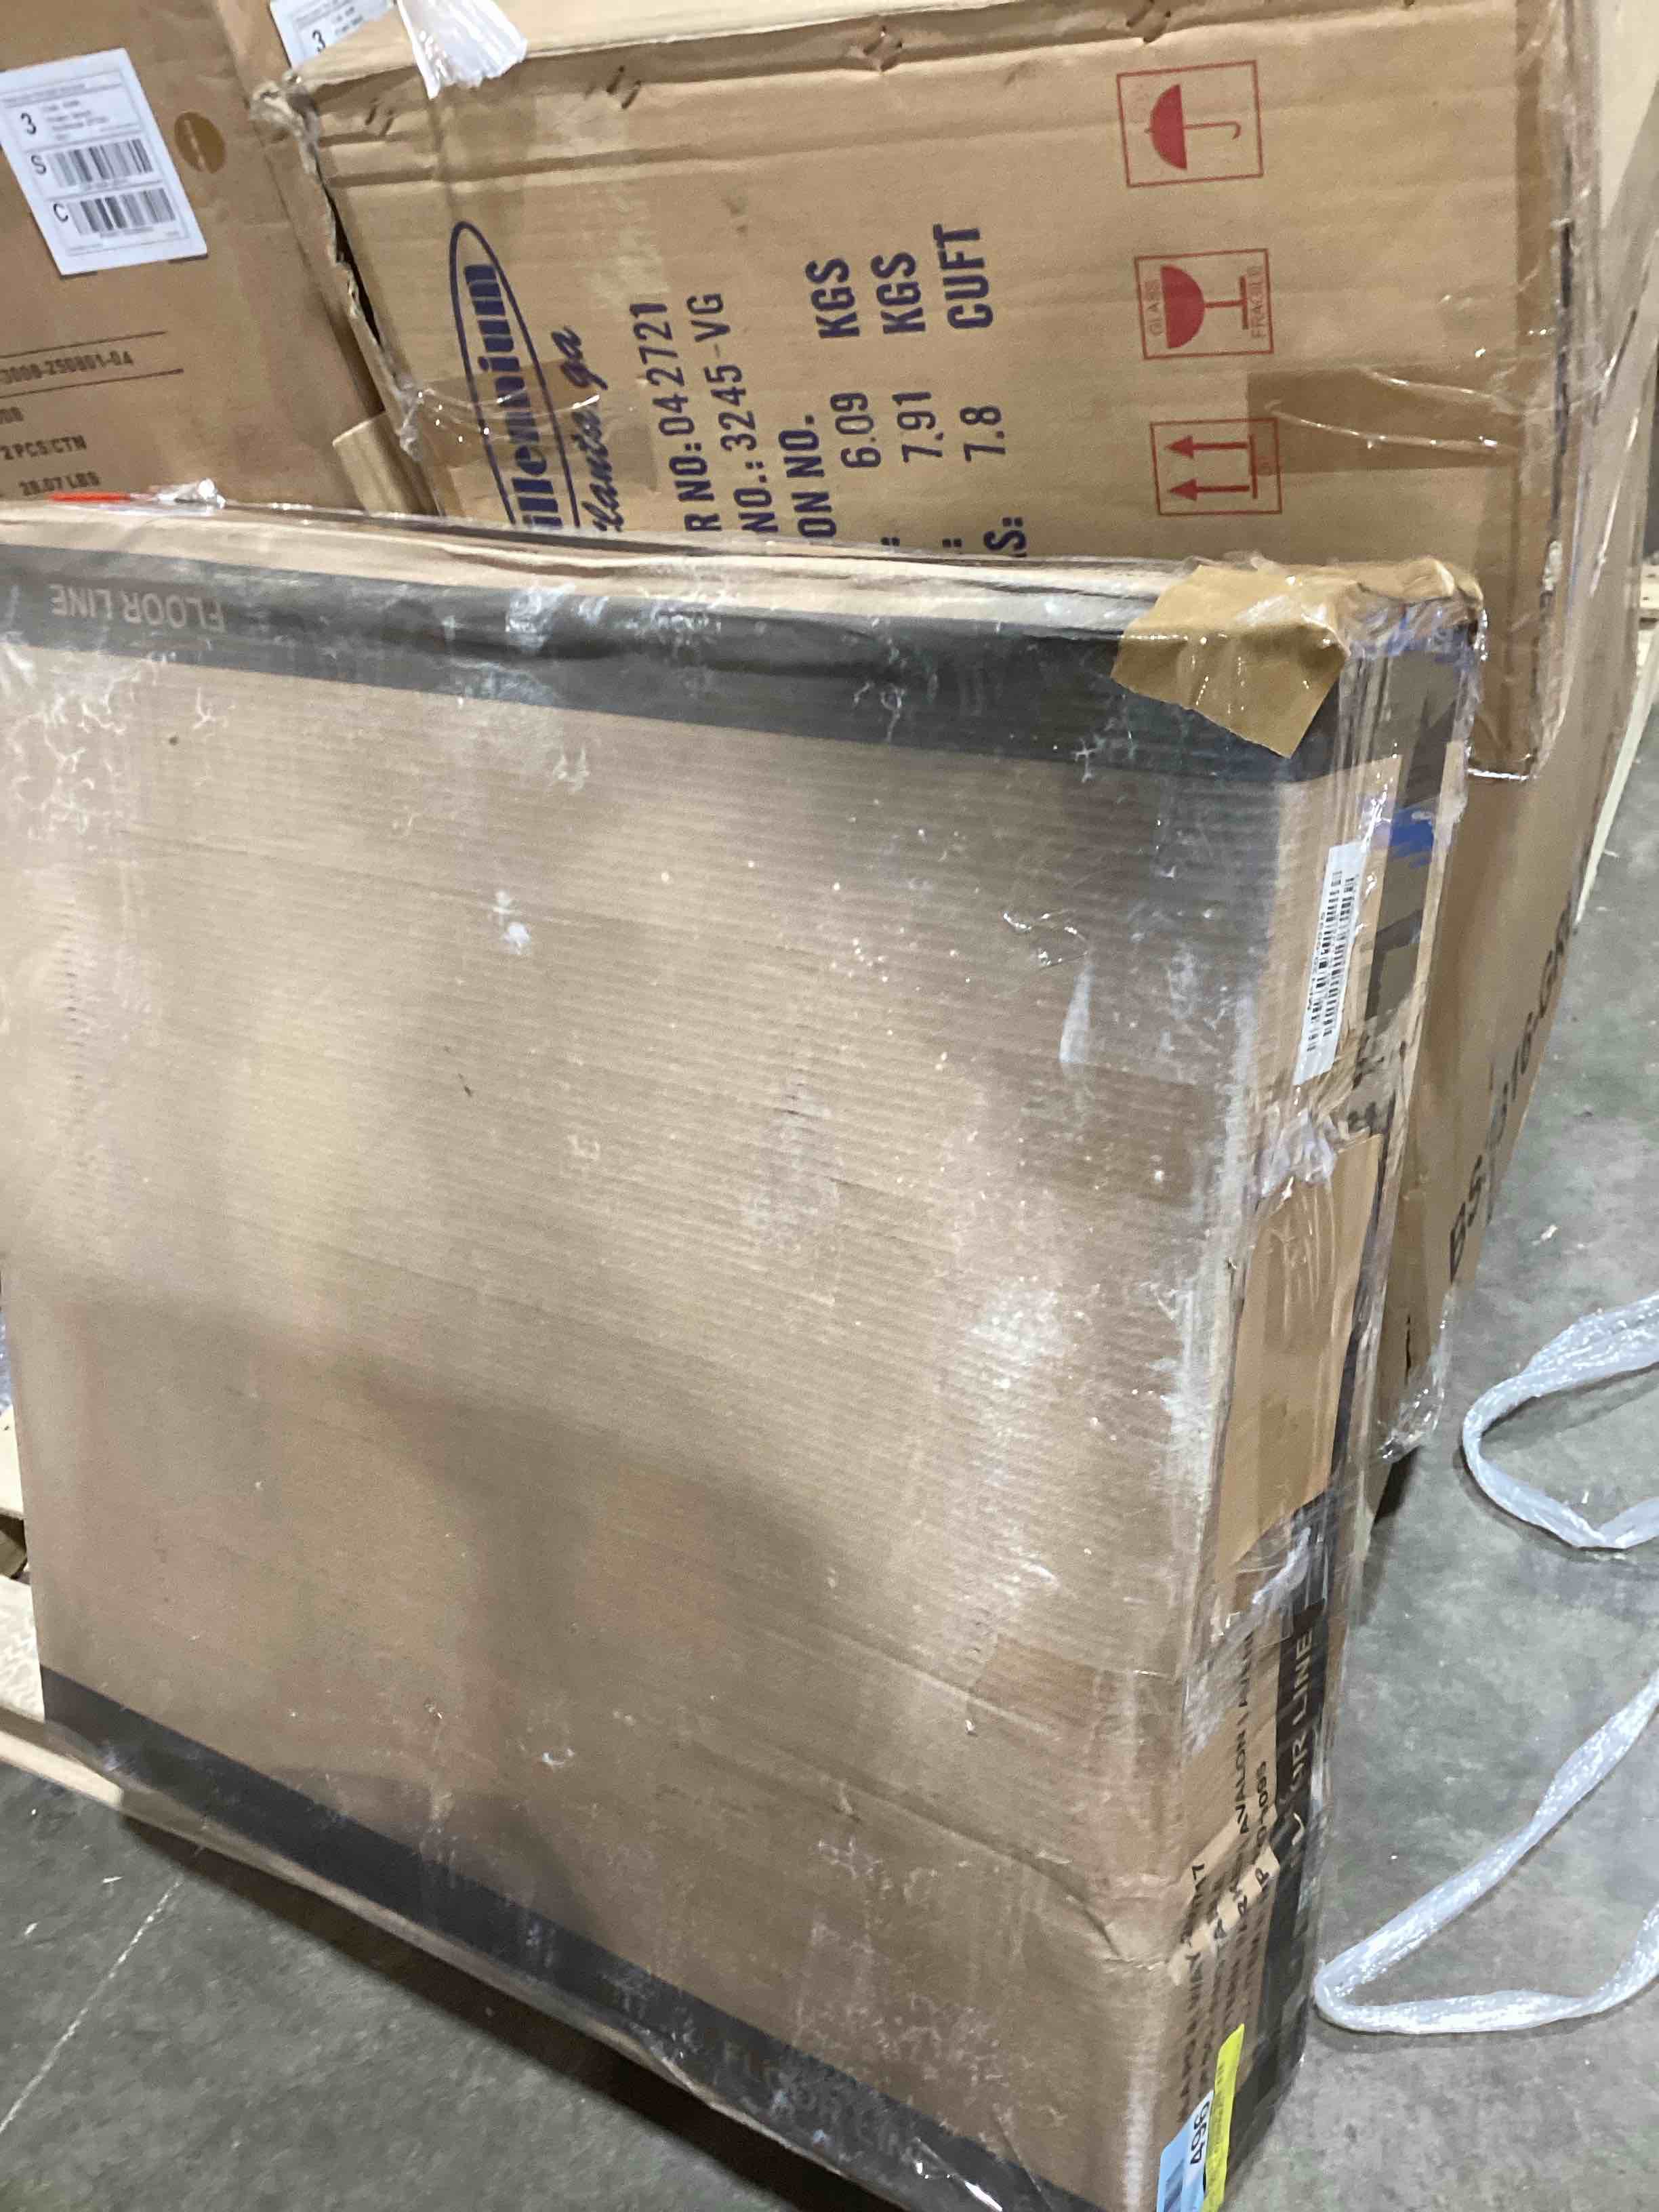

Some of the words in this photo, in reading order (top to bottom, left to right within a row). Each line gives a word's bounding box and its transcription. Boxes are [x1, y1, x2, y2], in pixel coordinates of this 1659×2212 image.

[20, 112, 37, 135] 3
[30, 155, 47, 174] S
[53, 203, 69, 222] C
[806, 256, 862, 340] KGS
[870, 251, 927, 335] KGS
[932, 222, 995, 331] CUFT
[462, 263, 565, 529] illennium
[830, 391, 882, 470] 6.09
[893, 390, 945, 464] 7.91
[778, 413, 826, 479] NO.
[959, 405, 1008, 462] 7.8
[48, 583, 113, 620] LINE
[121, 590, 228, 634] FLOOR
[1290, 1629, 1313, 1726] LINE
[1234, 1729, 1249, 1834] AVALON
